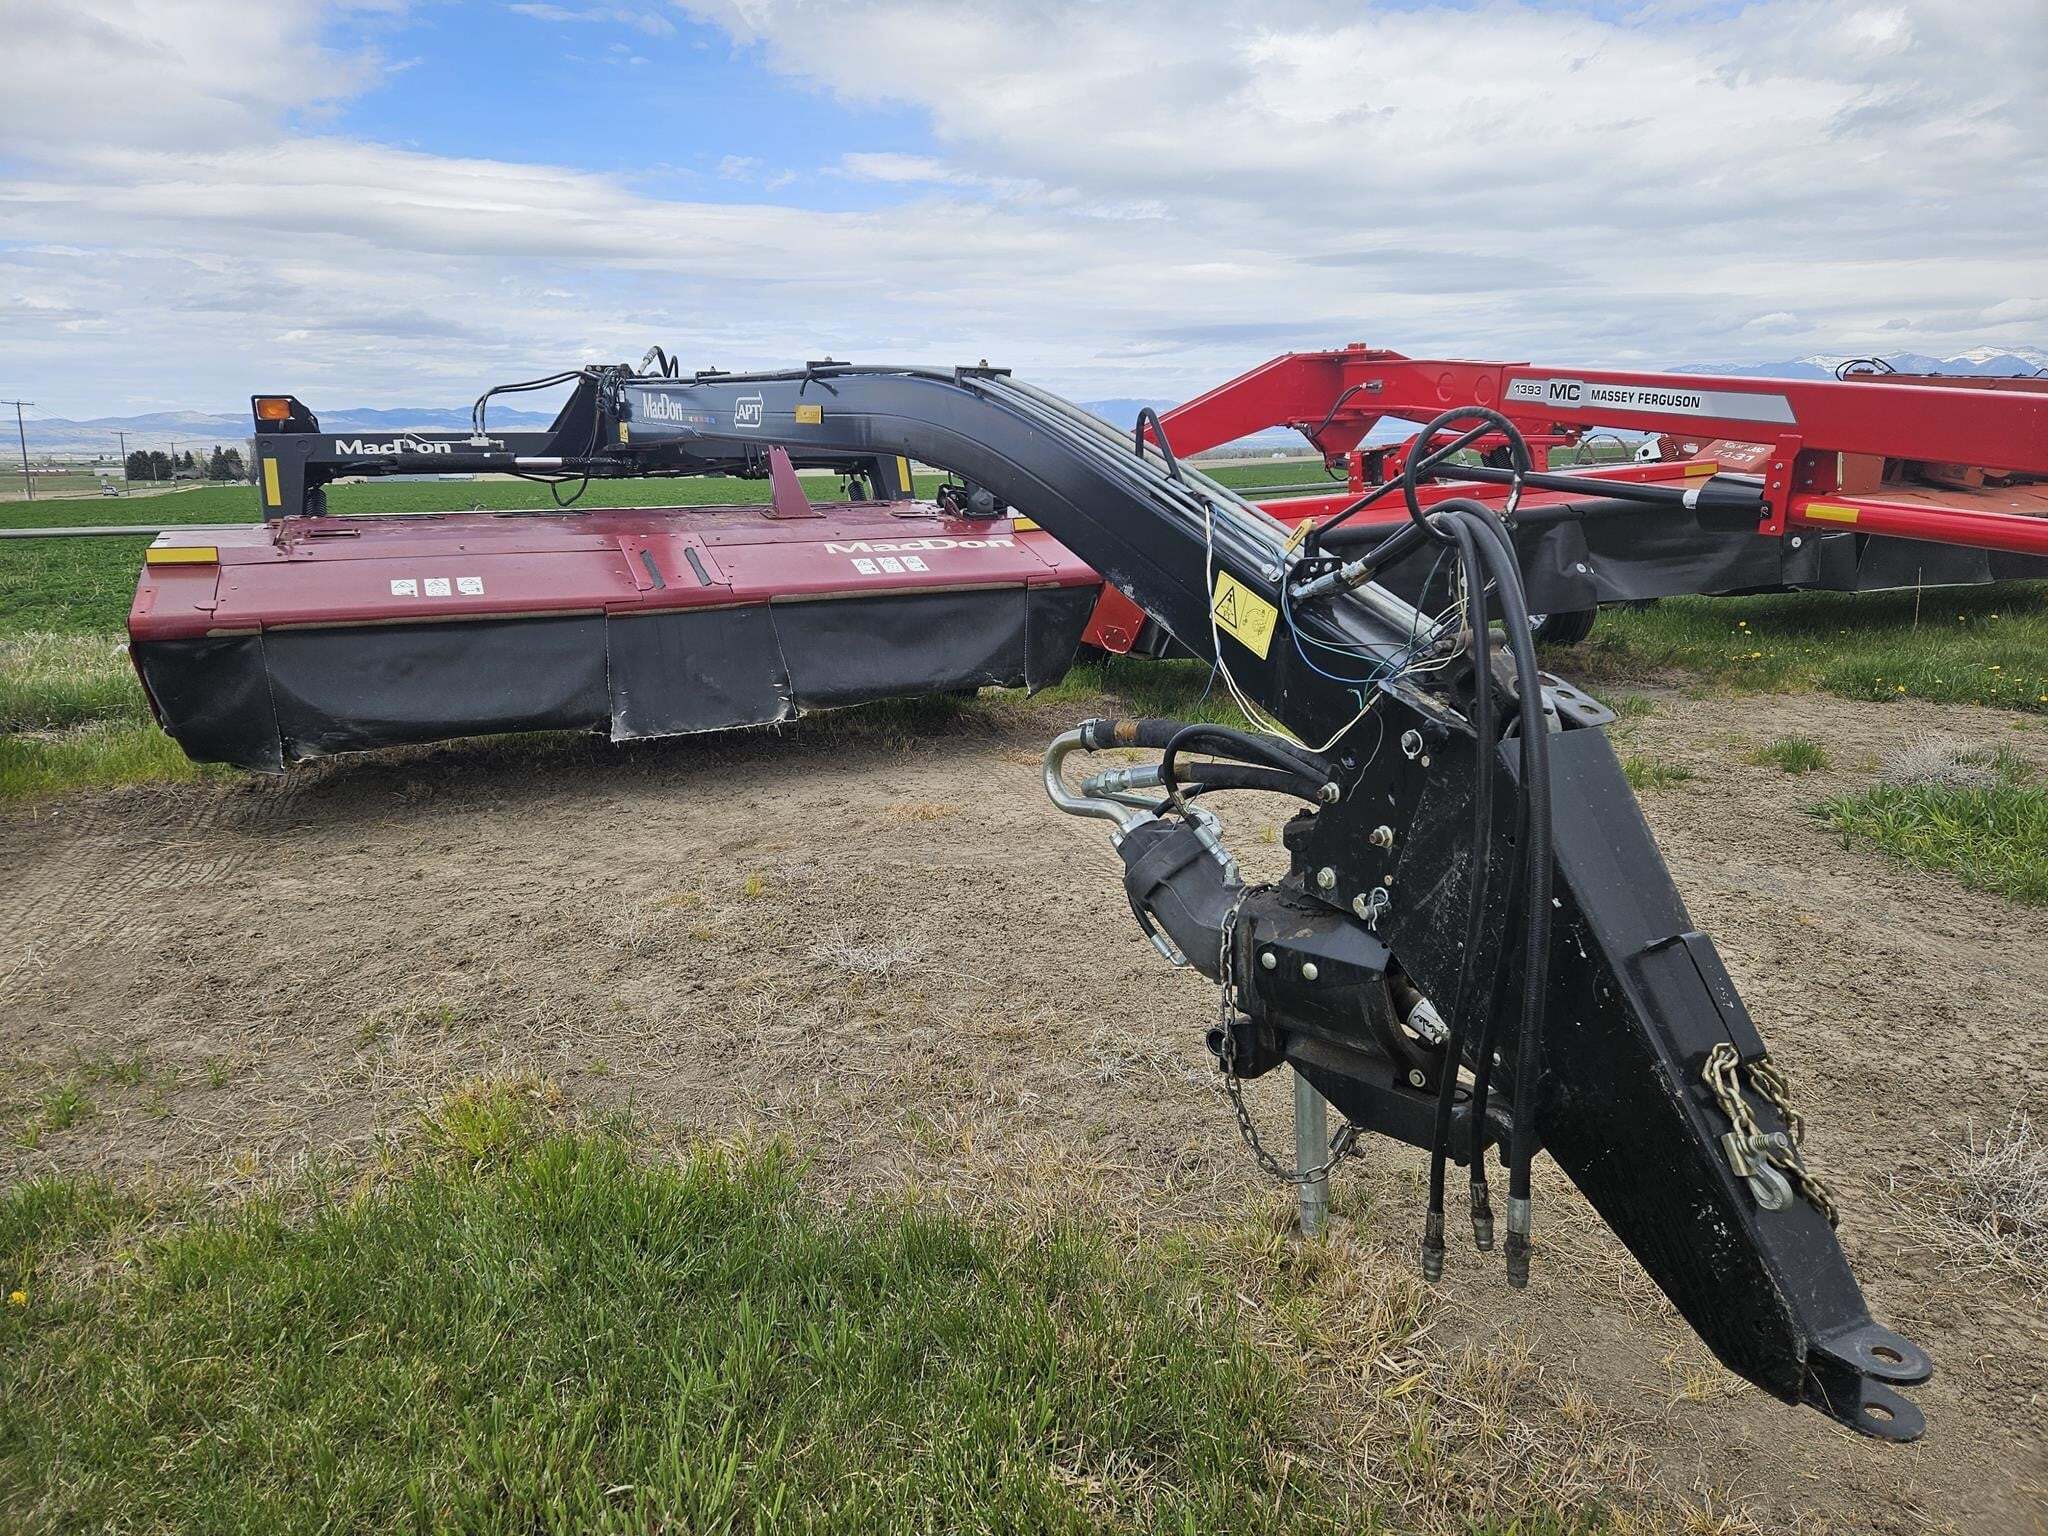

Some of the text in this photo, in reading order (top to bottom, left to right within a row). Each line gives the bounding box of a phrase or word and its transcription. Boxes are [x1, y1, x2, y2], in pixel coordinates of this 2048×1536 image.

[1514, 383, 1701, 408] 1393 MC MASSEY FERGUSON
[642, 393, 682, 420] MacDon
[737, 405, 761, 420] APT
[824, 539, 1015, 554] MacDon
